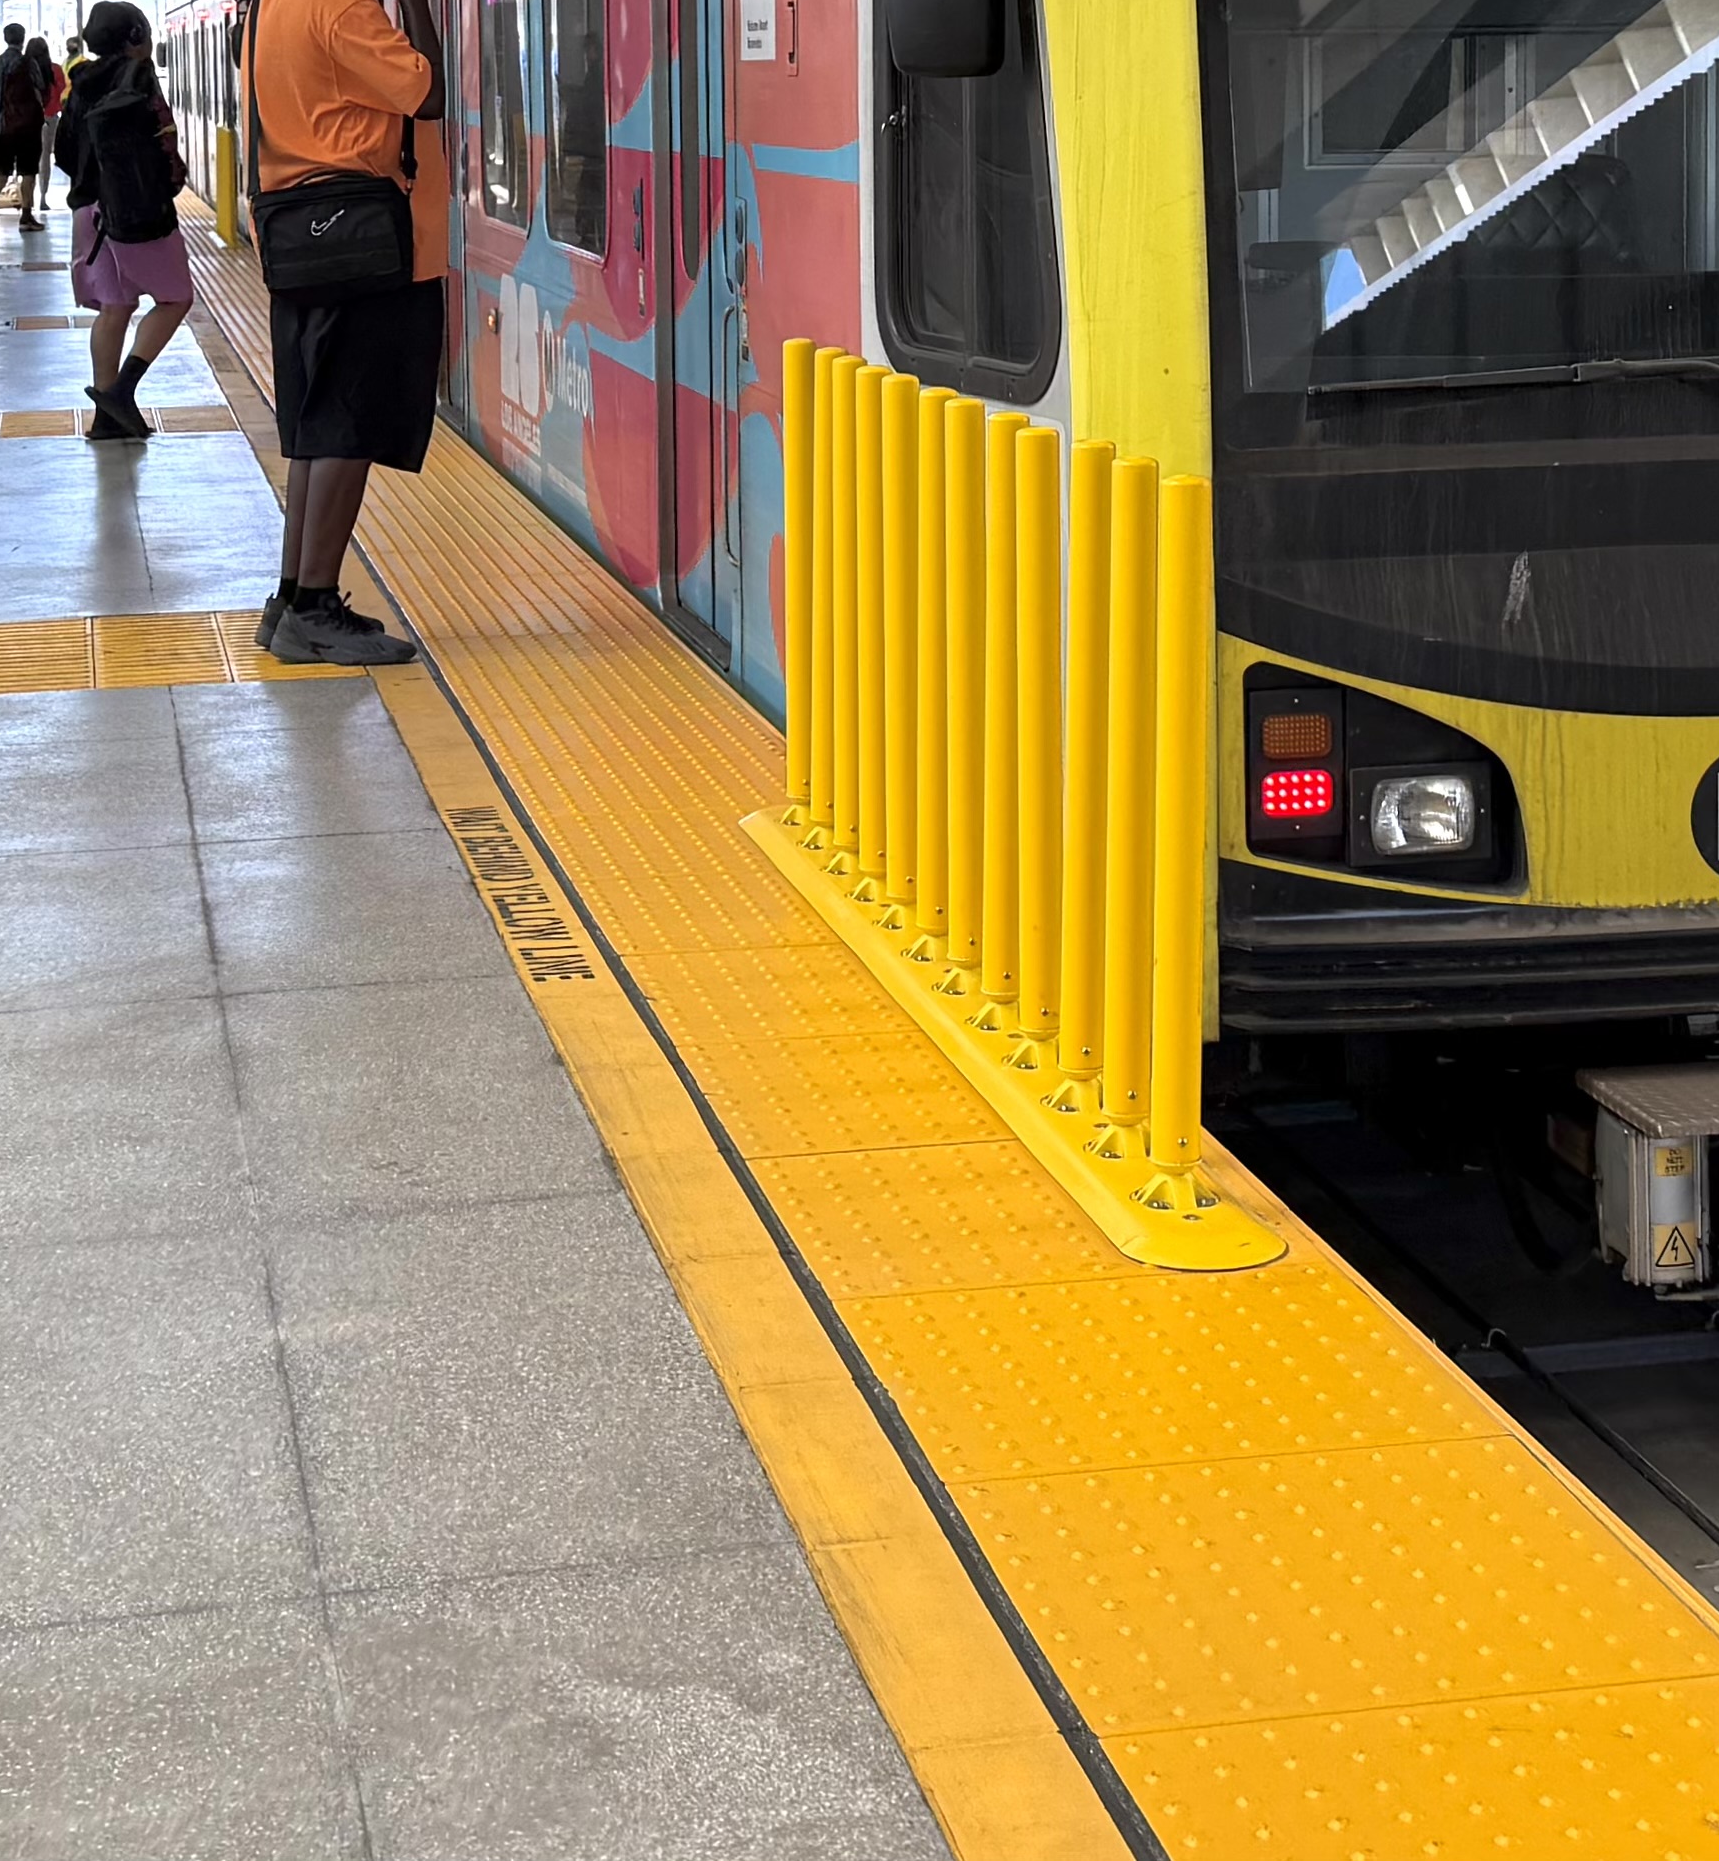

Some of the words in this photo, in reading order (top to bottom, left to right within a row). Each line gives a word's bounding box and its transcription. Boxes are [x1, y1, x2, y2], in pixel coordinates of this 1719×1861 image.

[445, 805, 509, 833] WAIT
[460, 835, 535, 882] BEHIND
[487, 882, 573, 941] YELLOW
[517, 945, 596, 983] LINE
